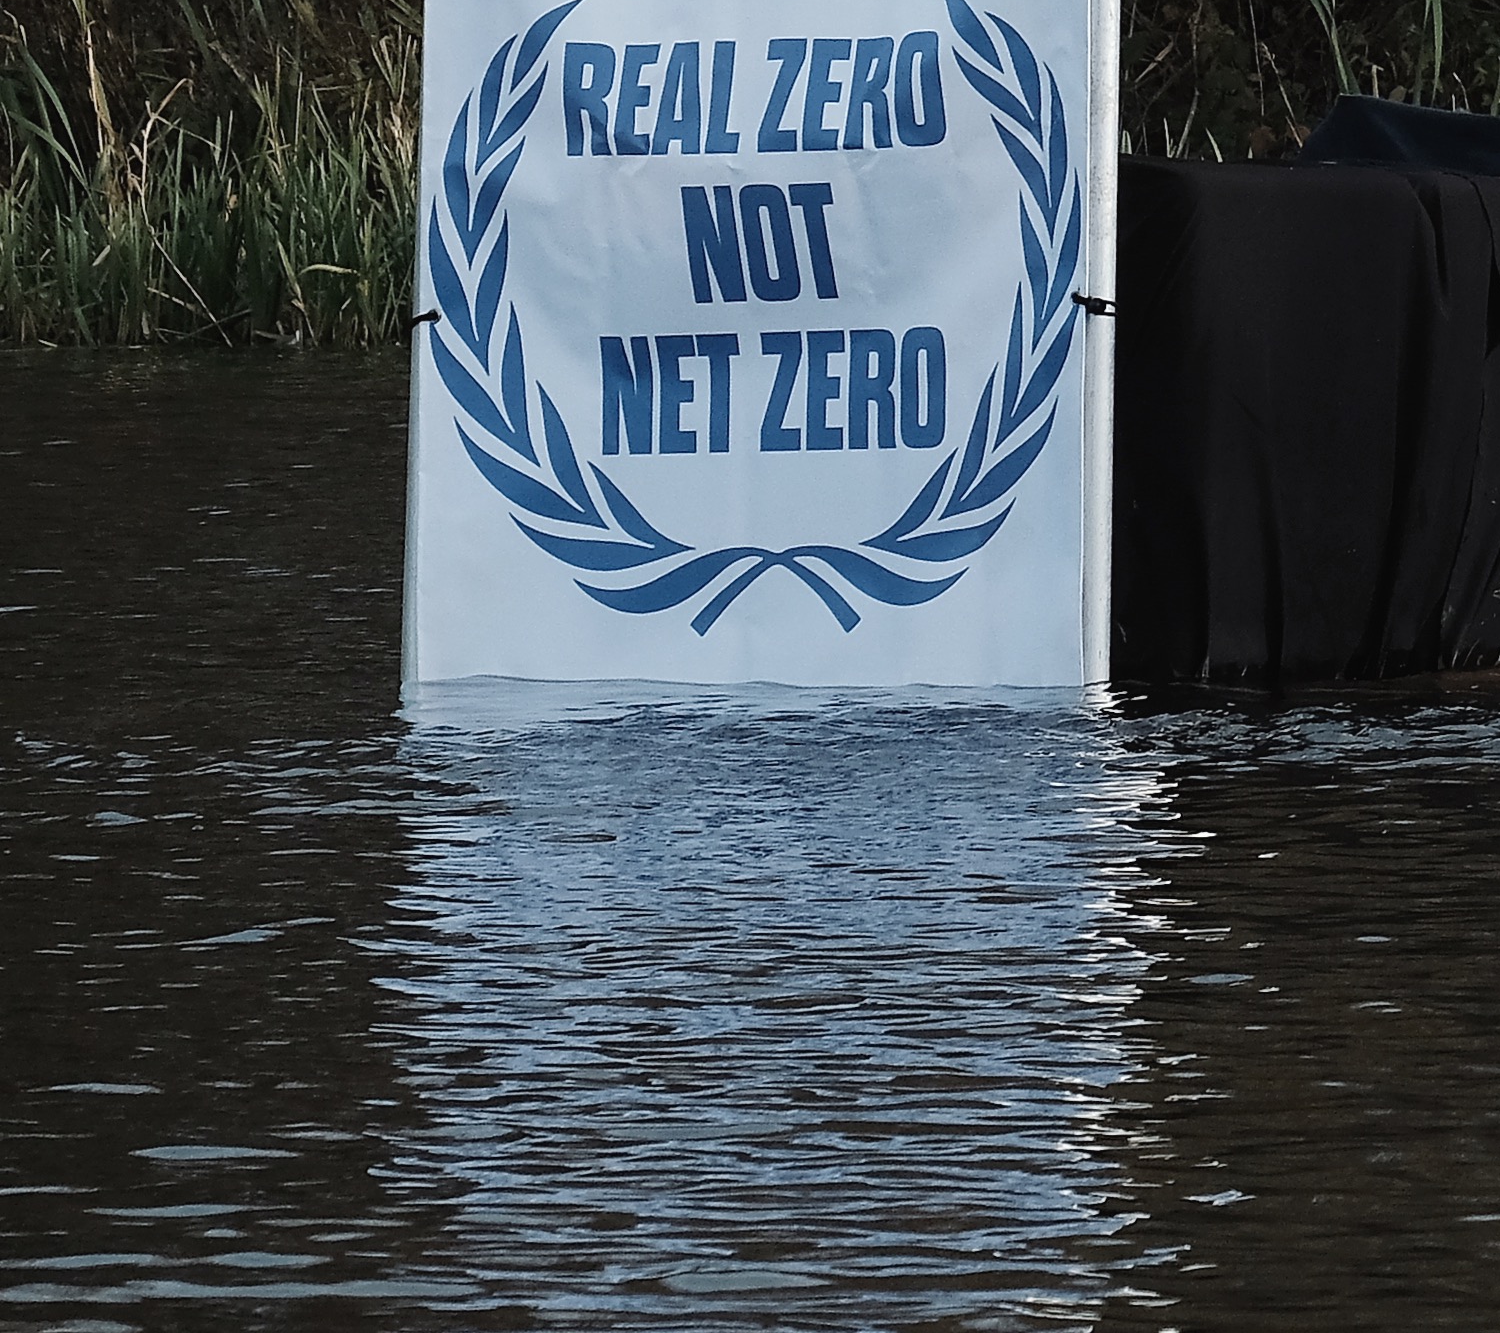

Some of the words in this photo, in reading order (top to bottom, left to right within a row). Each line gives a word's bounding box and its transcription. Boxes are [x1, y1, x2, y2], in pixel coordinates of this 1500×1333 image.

[563, 41, 740, 156] REAL
[758, 31, 946, 152] ZERO
[681, 183, 839, 303] NOT
[600, 333, 740, 455] NET
[760, 327, 946, 451] ZERO
